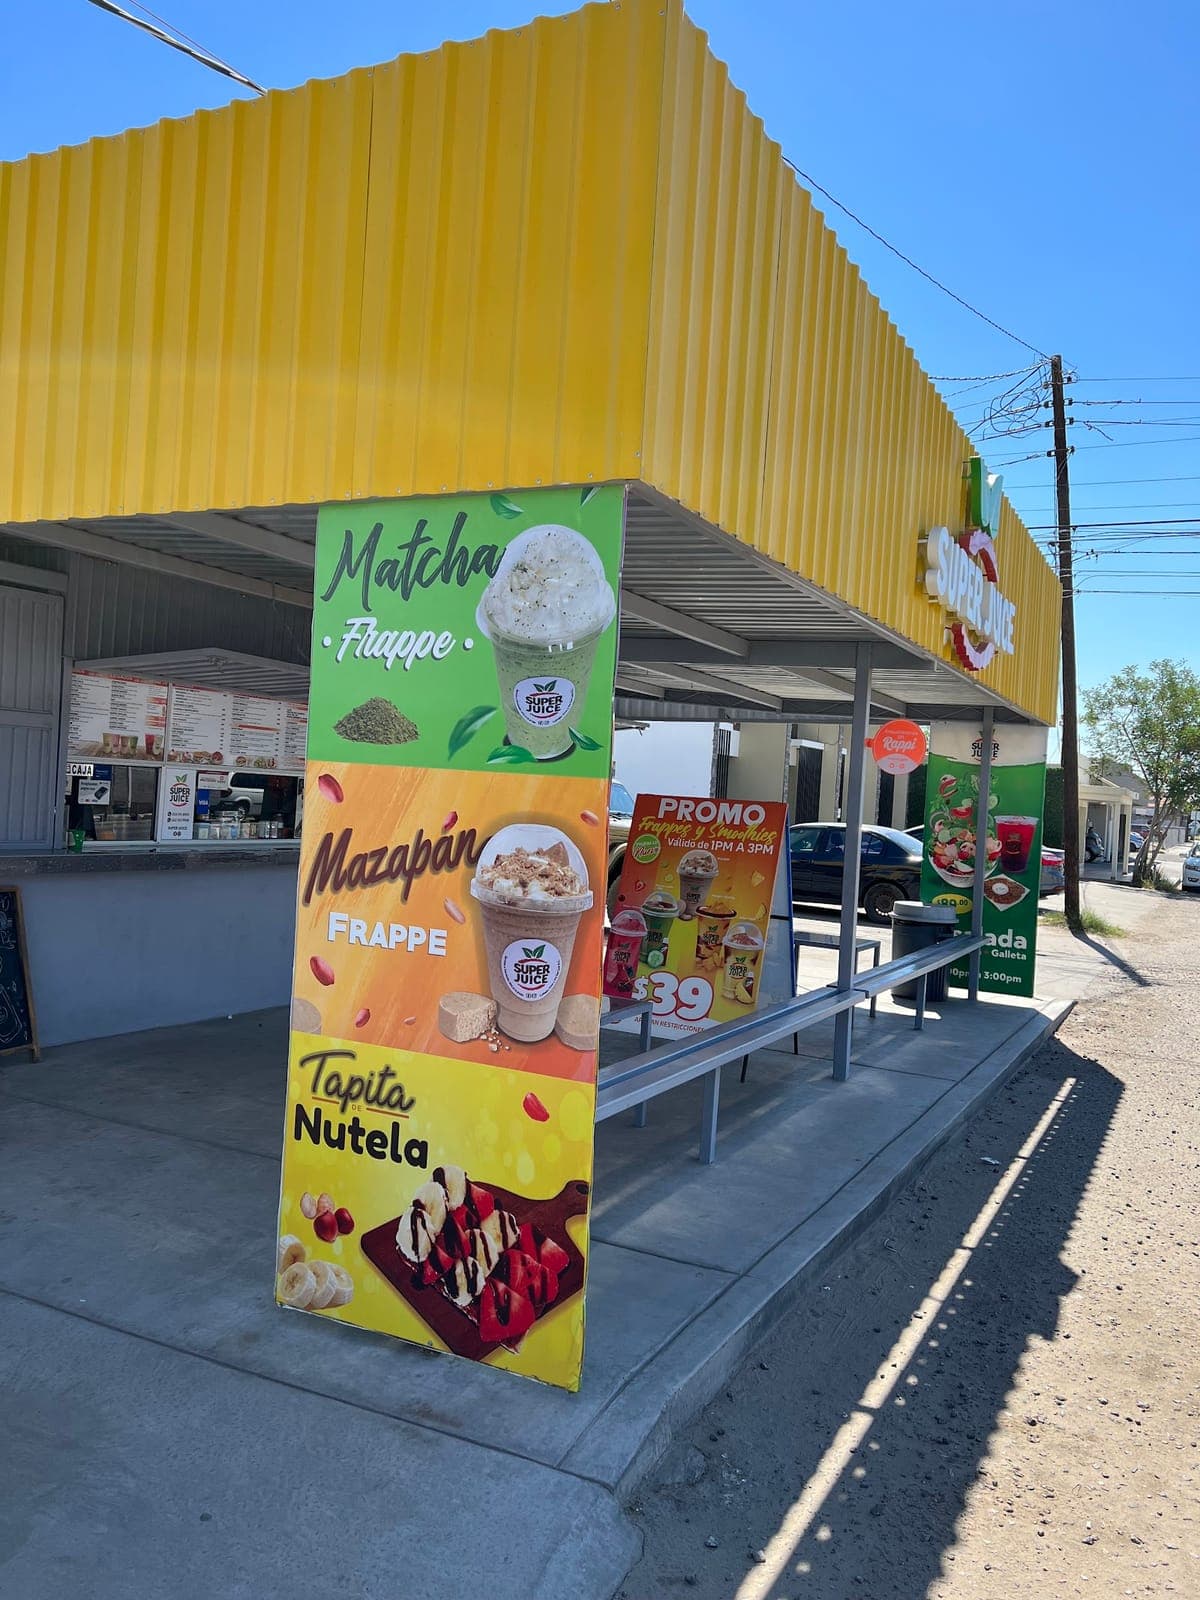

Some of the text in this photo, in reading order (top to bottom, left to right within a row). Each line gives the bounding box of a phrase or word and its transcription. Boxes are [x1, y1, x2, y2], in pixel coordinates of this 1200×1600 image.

[321, 511, 507, 612] Matcha
[926, 526, 1016, 656] SUPER JUICE
[335, 616, 456, 671] Frappe
[525, 695, 563, 706] SUPER
[525, 704, 561, 714] JUICE
[883, 736, 917, 752] Rappi
[971, 742, 1000, 751] SUR
[971, 750, 998, 758] JUE
[71, 764, 92, 775] CAJA
[169, 794, 189, 803] JUICE
[170, 787, 190, 795] SUPER
[657, 798, 766, 826] PROMO
[695, 824, 706, 841] y
[708, 821, 778, 845] Smoothies
[667, 838, 774, 855] Válido de 1PM A 3PM
[304, 826, 492, 904] Mazapán
[327, 911, 448, 956] FRAPPE
[991, 949, 1027, 961] Galleta
[514, 962, 550, 975] SUPER
[514, 973, 549, 985] JUICE
[983, 971, 1022, 984] 3:00pm
[631, 971, 714, 1021] $39
[300, 1050, 416, 1114] Tapita
[293, 1103, 429, 1169] Nutela
